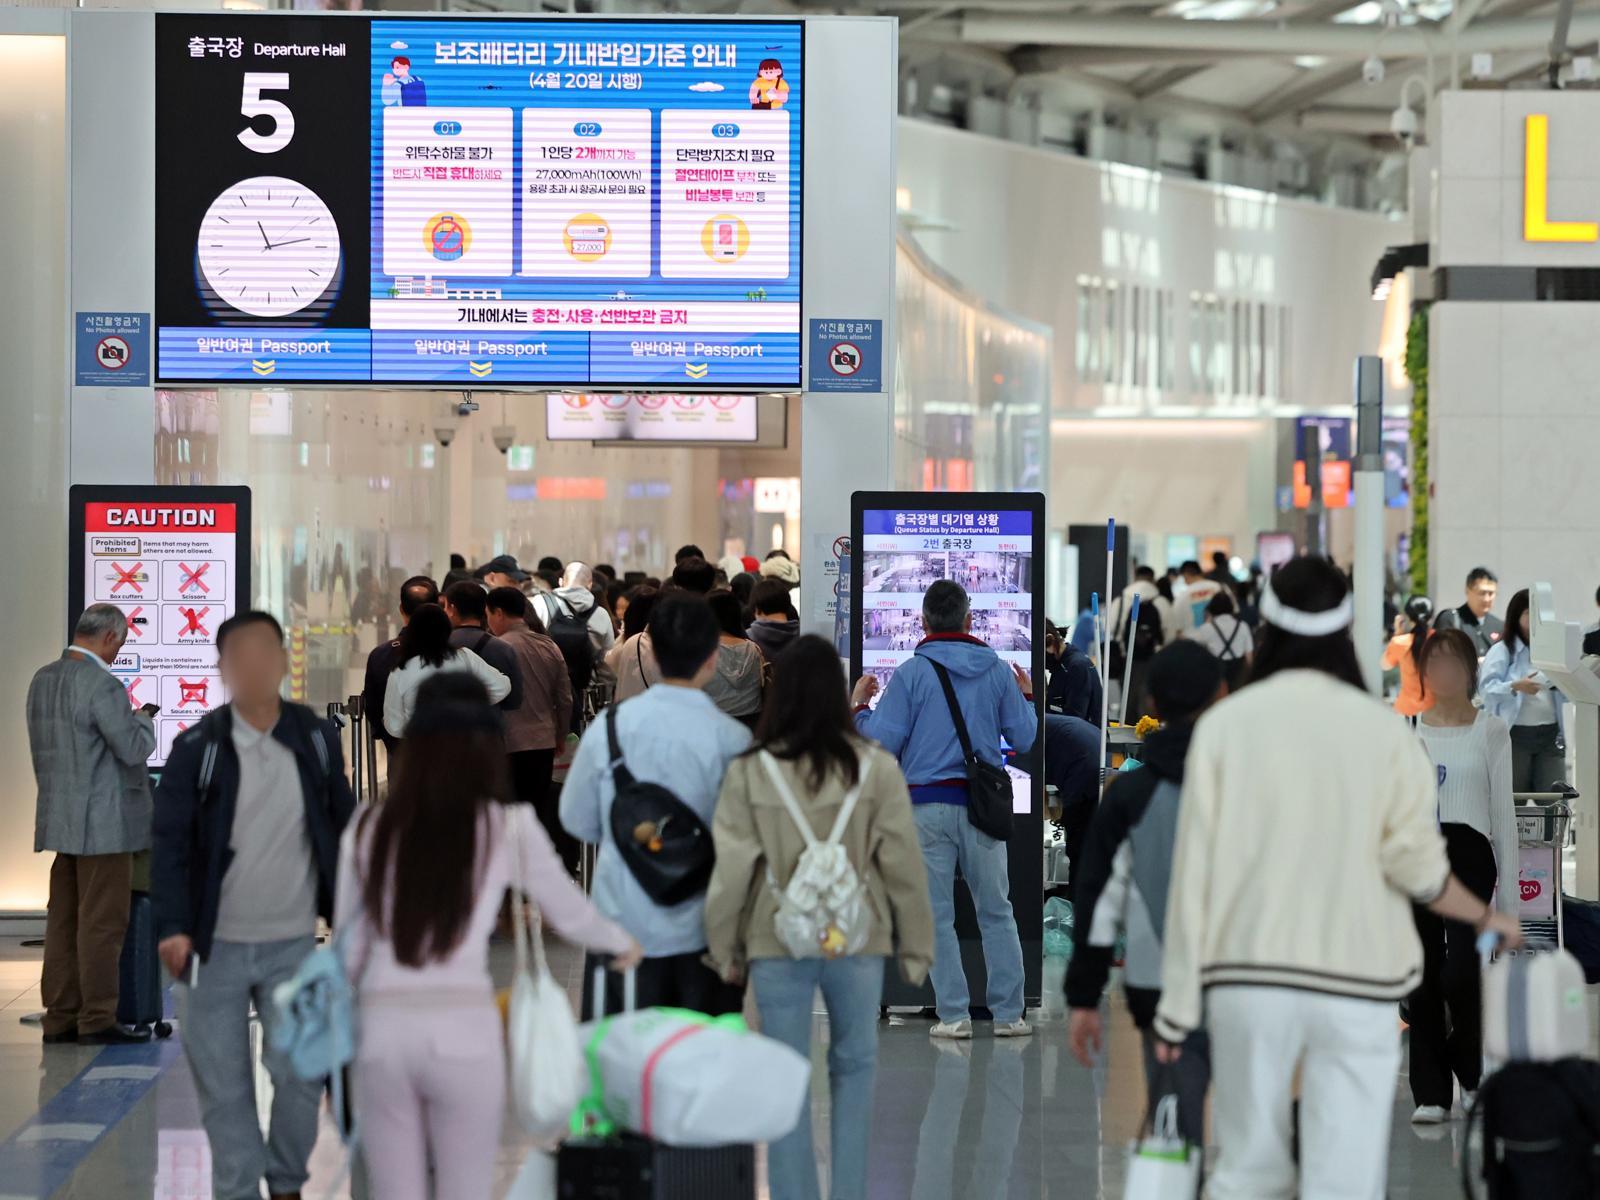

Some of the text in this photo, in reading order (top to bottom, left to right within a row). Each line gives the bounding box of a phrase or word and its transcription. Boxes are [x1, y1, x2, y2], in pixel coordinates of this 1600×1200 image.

[188, 36, 347, 59] 출국장 Departure Hall
[434, 42, 737, 68] 보조배터리 기내반입기준 안내
[529, 72, 643, 90] (4월 20일 시행)
[236, 72, 295, 154] 5
[441, 122, 456, 134] 01
[579, 124, 596, 135] 02
[717, 125, 734, 137] 03
[405, 146, 494, 160] 위탁수하물 불가
[540, 146, 637, 160] 1인당 2개까지 가능
[676, 148, 776, 162] 단락방지조치 필요
[392, 166, 503, 181] 반드시 직접 휴대하세요
[535, 169, 642, 181] 27,000mAh(100Wh)
[675, 168, 735, 182] 절연테이프
[757, 172, 777, 183] 또는
[1523, 114, 1600, 242] L
[549, 184, 567, 195] 초과
[569, 184, 578, 194] 시
[580, 184, 607, 195] 항공사
[608, 184, 627, 195] 문의
[628, 185, 646, 195] 필요
[685, 188, 734, 202] 비닐봉투
[457, 308, 528, 324] 기내에서는
[659, 309, 688, 325] 금지
[819, 322, 873, 334] 사진촬영금지
[849, 333, 872, 341] allowed
[196, 337, 331, 356] 일반여권 Passport
[414, 339, 548, 358] 일반여권 Passport
[630, 341, 763, 359] 일반여권 Passport
[106, 508, 216, 526] CAUTION
[895, 513, 1000, 526] 출국장별 대기열 상황
[894, 526, 918, 534] (Queue
[941, 526, 949, 535] by
[950, 527, 984, 535] Departure
[984, 527, 1000, 535] Hall)
[95, 539, 136, 547] Prohibited
[922, 538, 973, 550] 2번 출국장
